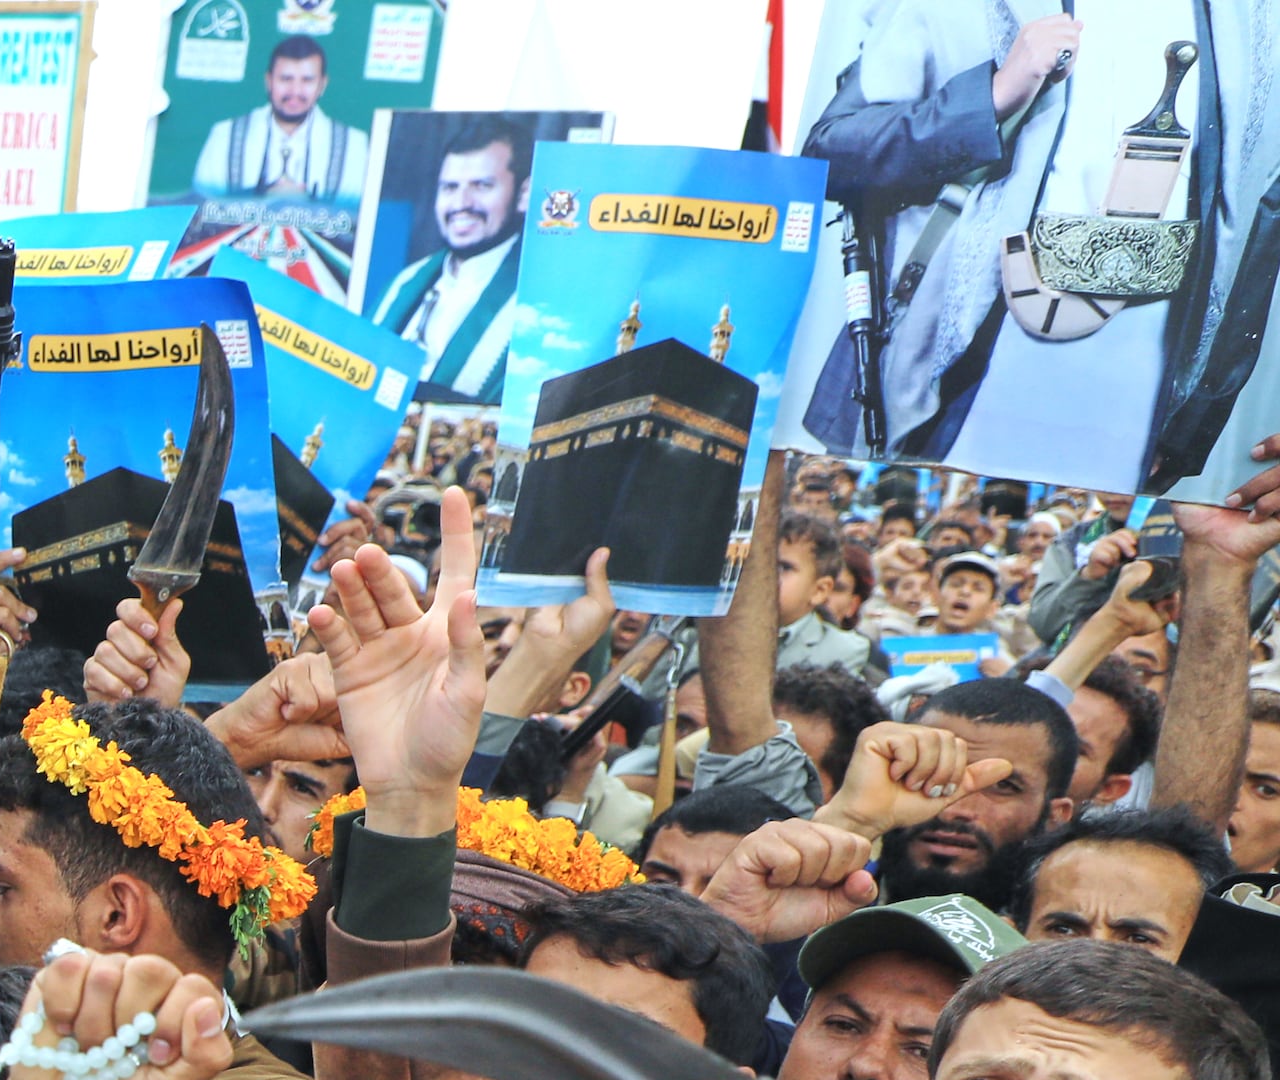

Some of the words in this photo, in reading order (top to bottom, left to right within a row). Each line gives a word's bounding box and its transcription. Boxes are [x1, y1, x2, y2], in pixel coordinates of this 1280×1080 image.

[598, 202, 669, 226] الفداء
[673, 205, 705, 229] لها
[708, 206, 772, 240] أرواحنا
[48, 254, 75, 271] لها
[75, 247, 128, 275] أرواحنا
[32, 342, 82, 365] الفداء
[87, 341, 120, 362] لها
[128, 330, 200, 363] أرواحنا
[292, 332, 319, 357] لها
[320, 346, 372, 385] أرواحنا
